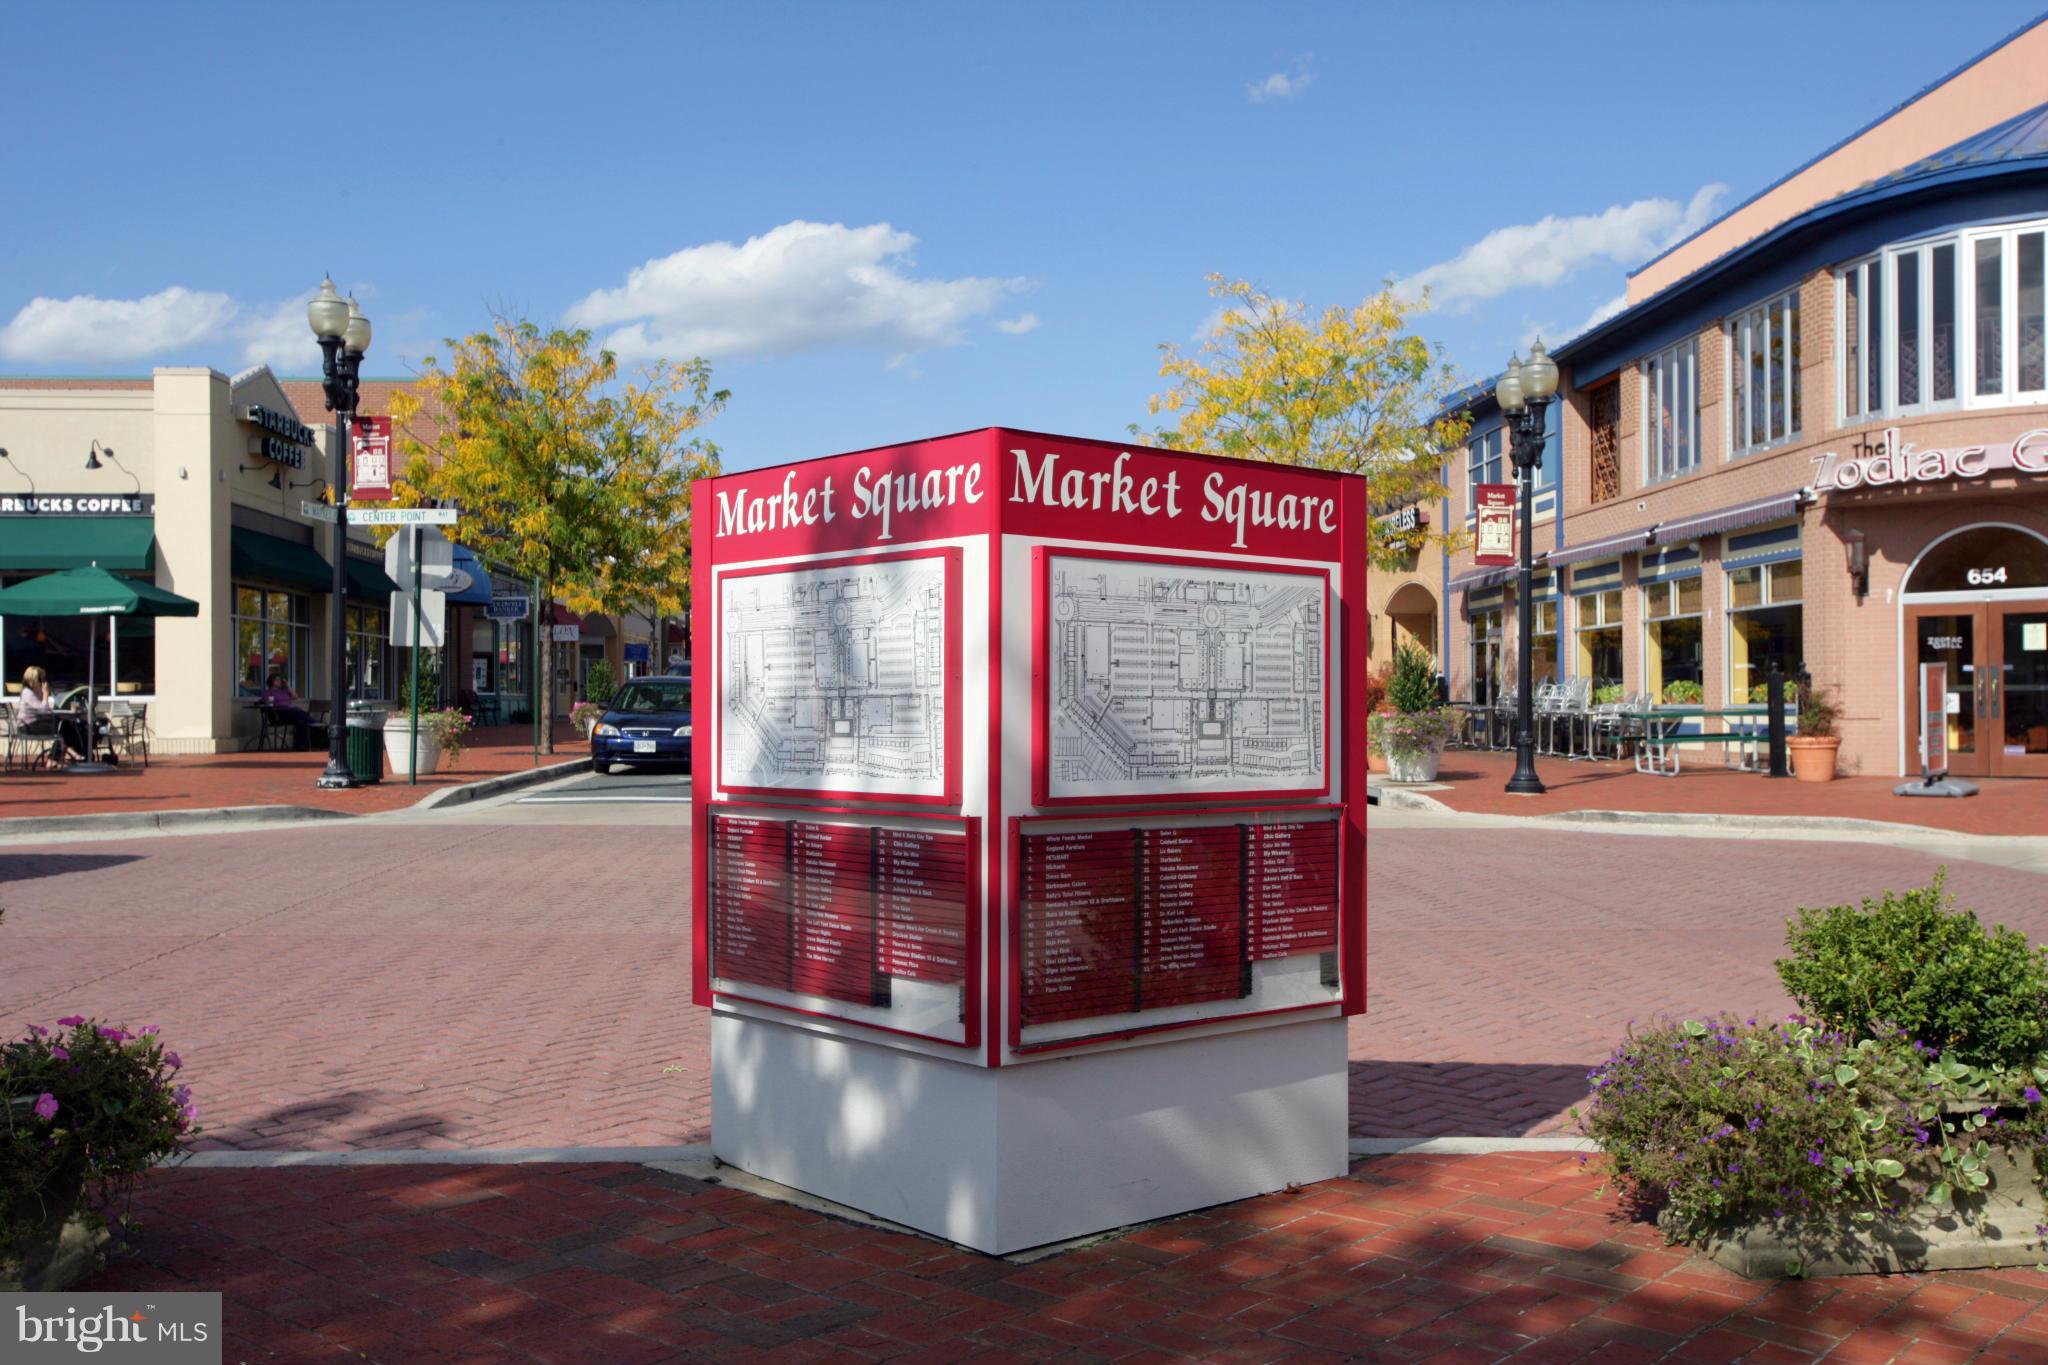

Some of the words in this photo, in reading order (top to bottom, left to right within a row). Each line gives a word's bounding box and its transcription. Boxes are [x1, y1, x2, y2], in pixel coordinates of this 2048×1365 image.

[1853, 432, 1886, 459] The
[1810, 427, 1989, 492] Zodiac
[0, 498, 73, 512] RBUCKS
[76, 498, 142, 512] COFFEE
[716, 470, 836, 538] Market
[851, 461, 984, 540] Square
[1009, 448, 1181, 519] Market
[1201, 471, 1337, 549] Square
[363, 512, 396, 522] CENTER
[401, 512, 426, 521] POINT
[1966, 567, 2008, 585] 654
